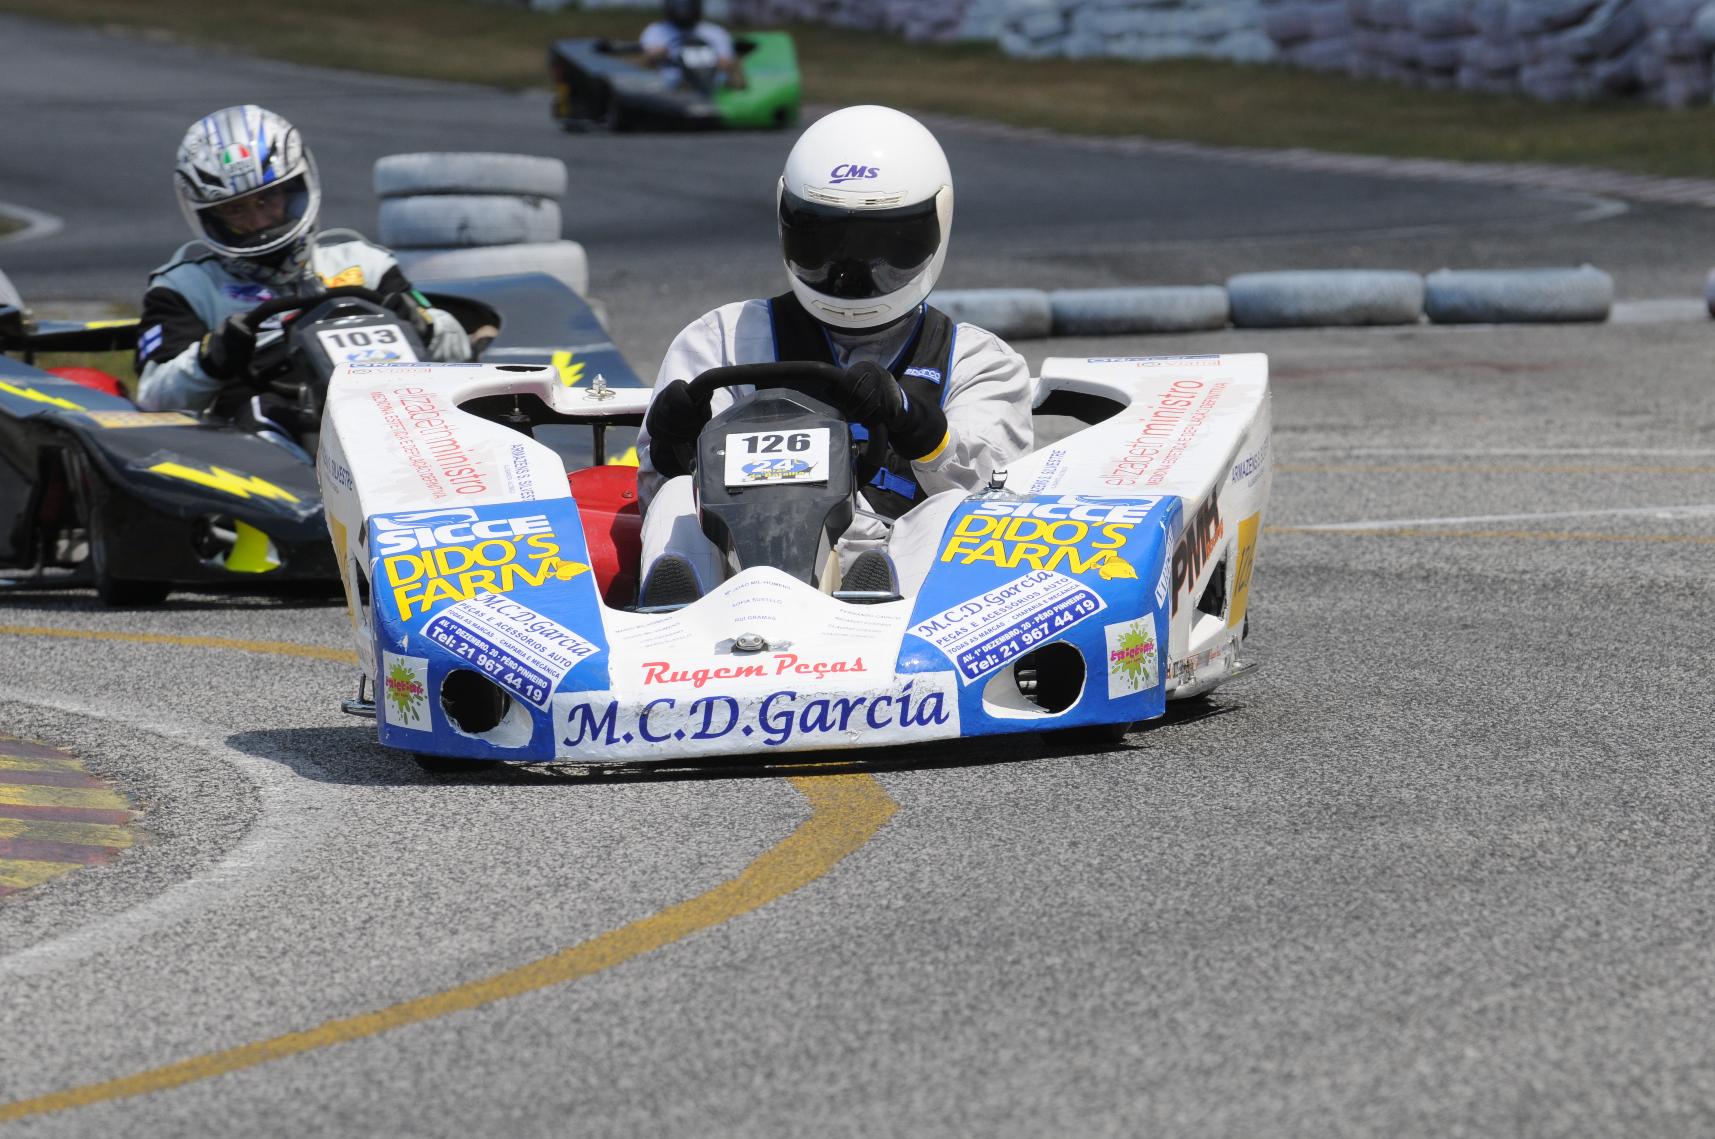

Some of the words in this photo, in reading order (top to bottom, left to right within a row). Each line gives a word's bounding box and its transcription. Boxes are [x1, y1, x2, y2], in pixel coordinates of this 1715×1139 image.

[830, 164, 880, 180] CMS
[328, 330, 398, 348] 103
[742, 433, 811, 453] 126
[973, 502, 1153, 524] SICCE
[376, 515, 553, 555] SICCE
[953, 515, 1135, 549] DIDO'S
[383, 533, 561, 587] DIDO'S
[1043, 577, 1069, 592] AUTO
[472, 622, 495, 638] MARCAS
[500, 639, 525, 657] CHAPARIA
[949, 642, 969, 656] TODAS
[979, 622, 1005, 639] MARCAS
[1012, 602, 1042, 620] CHAPARIA
[962, 652, 975, 664] AV.
[1053, 593, 1086, 612] PINHEIRO
[967, 653, 999, 675] Tel:
[1000, 640, 1020, 658] 21
[1021, 623, 1051, 645] 967
[1054, 611, 1074, 628] 44
[1075, 599, 1096, 615] 19
[431, 626, 456, 648] Tel:
[457, 642, 475, 659] 21
[477, 654, 504, 675] 967
[504, 672, 523, 689] 44
[526, 685, 543, 701] 19
[517, 665, 548, 688] PINHEIRO
[549, 652, 572, 668] AUTO
[641, 661, 768, 688] Rugem
[772, 653, 867, 679] Peças
